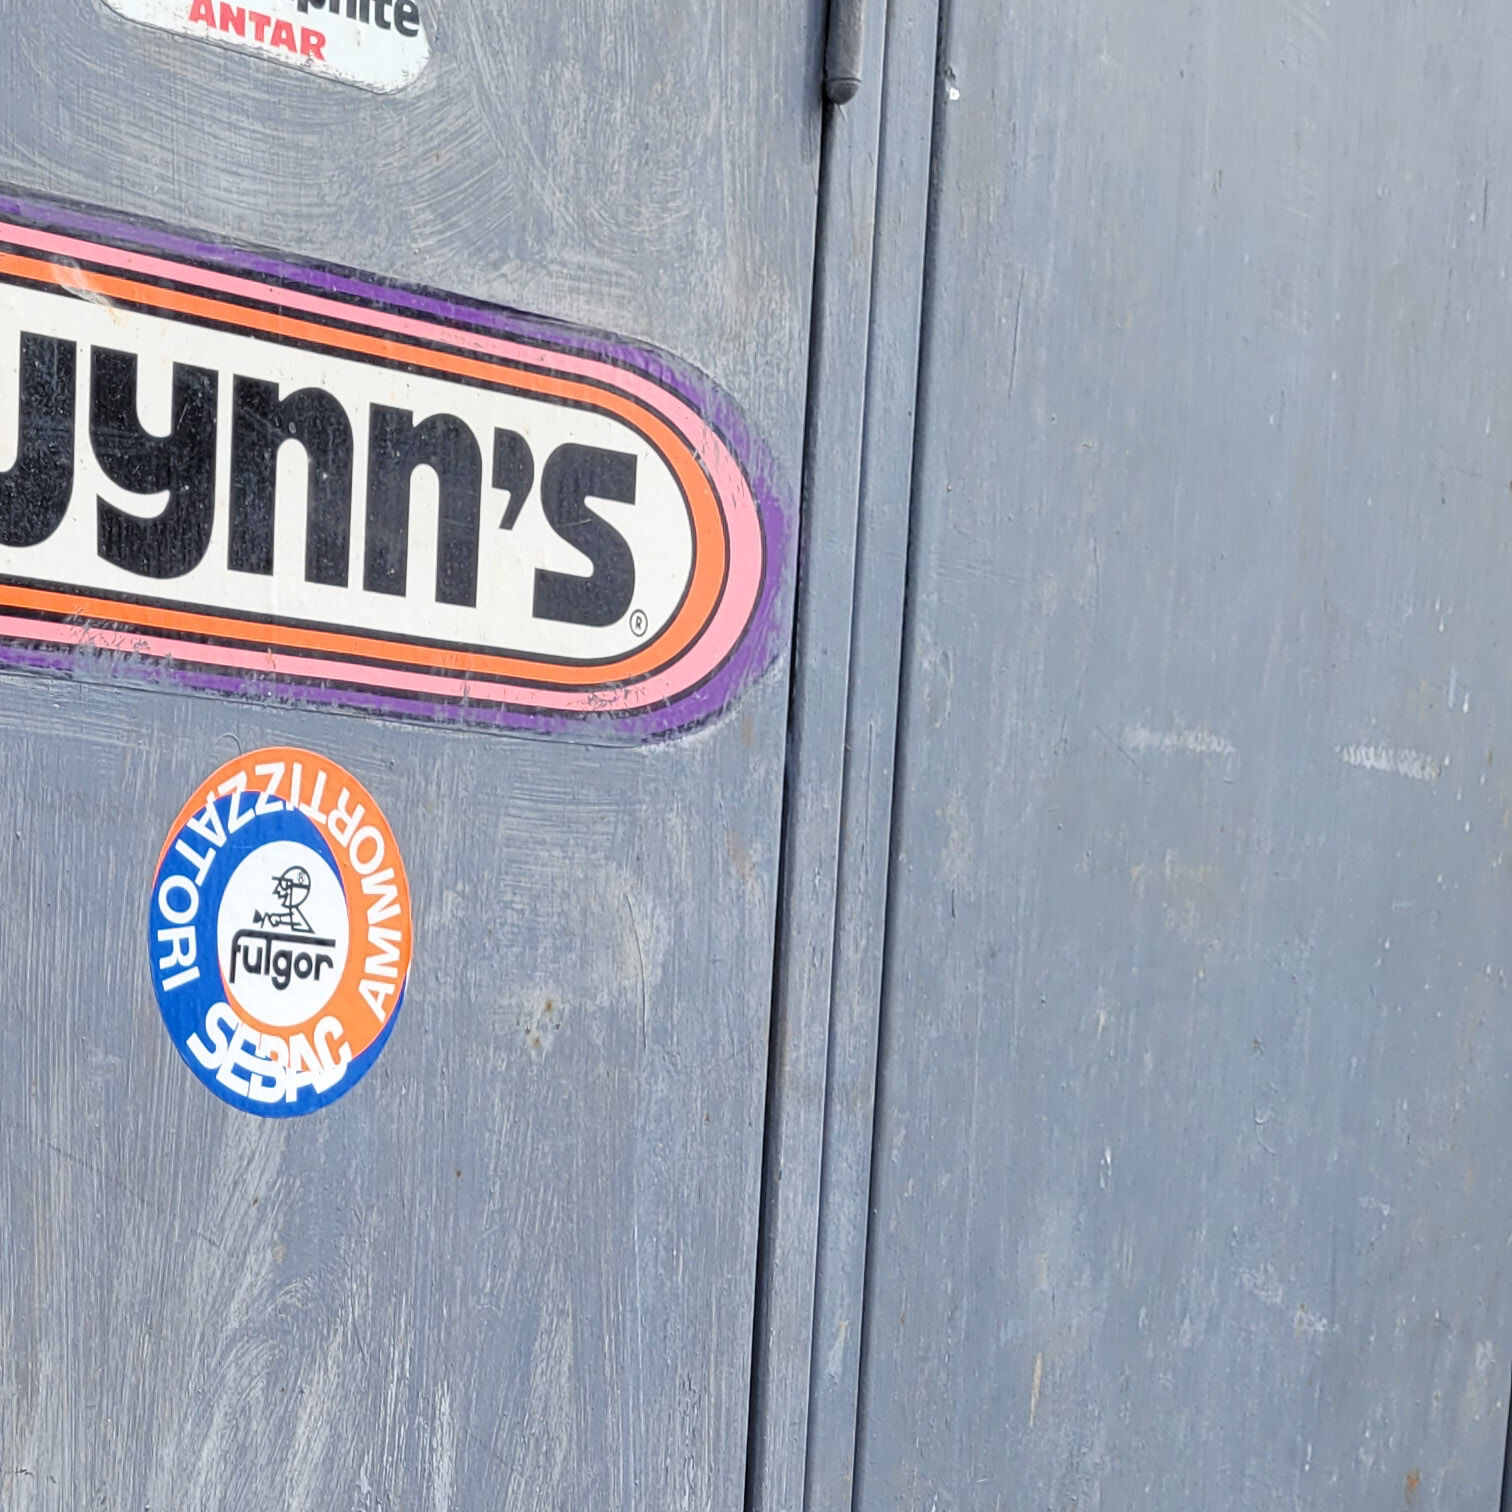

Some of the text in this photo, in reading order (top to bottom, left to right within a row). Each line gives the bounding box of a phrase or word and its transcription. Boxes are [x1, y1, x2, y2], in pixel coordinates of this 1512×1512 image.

[188, 0, 326, 61] ANTAR
[157, 761, 402, 1024] AMMORTIZZATORI
[228, 928, 336, 991] fulgor
